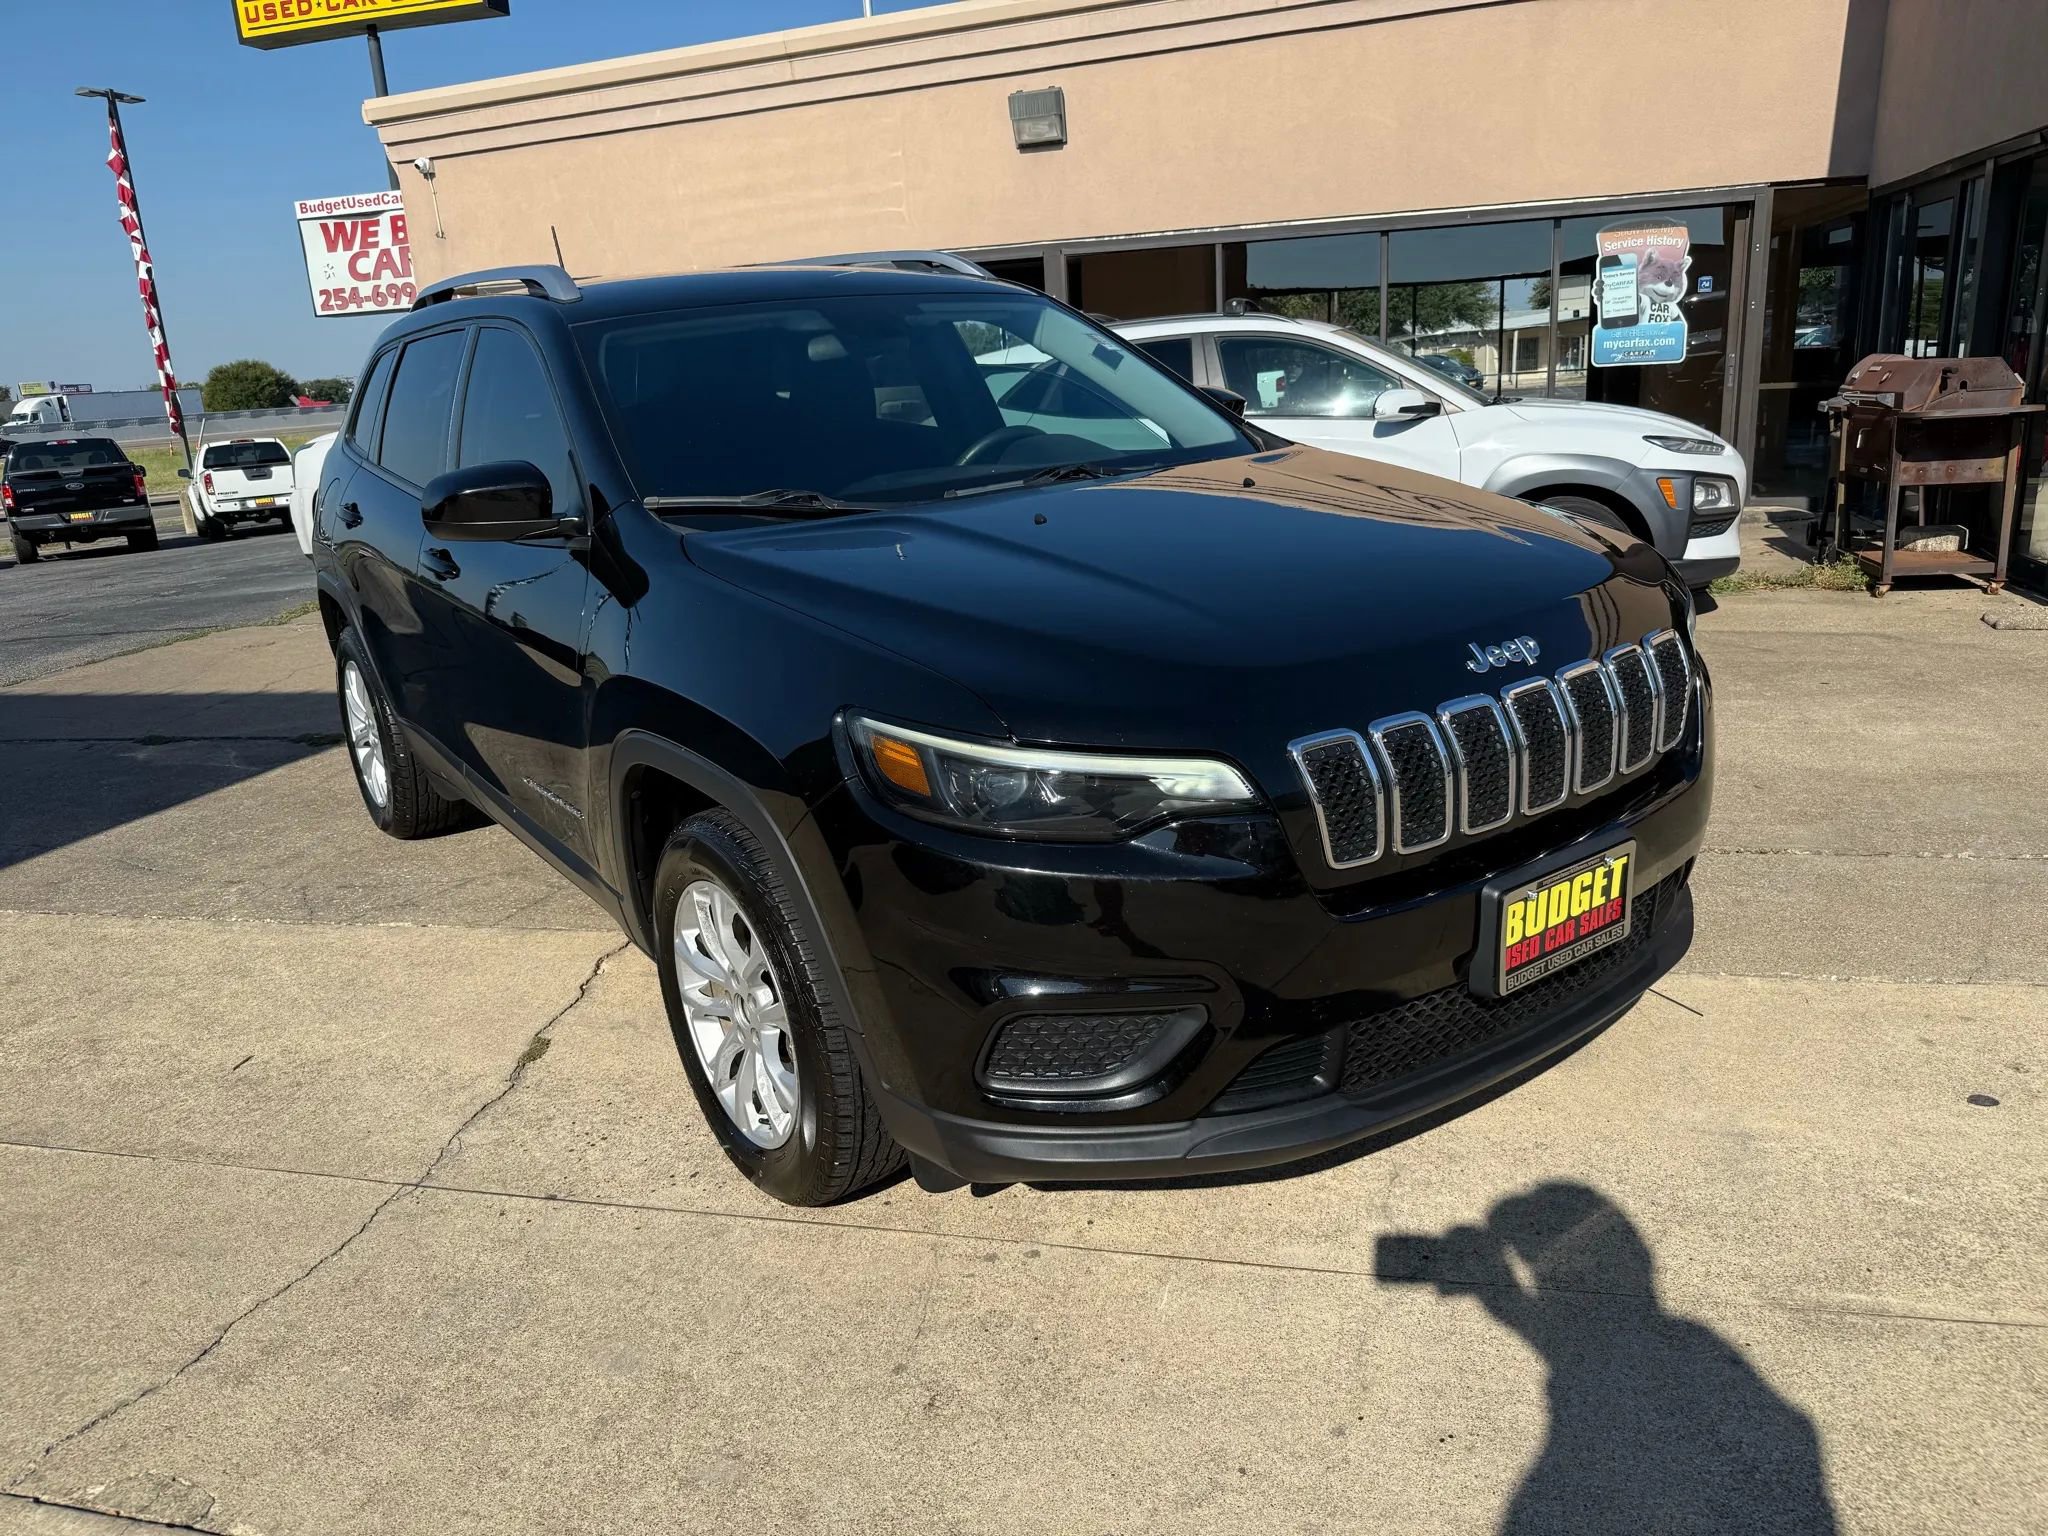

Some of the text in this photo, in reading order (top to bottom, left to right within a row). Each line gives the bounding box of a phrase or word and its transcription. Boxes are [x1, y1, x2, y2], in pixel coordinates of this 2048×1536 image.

[244, 0, 313, 24] USED
[319, 218, 380, 253] WE
[1604, 235, 1685, 252] Service History
[319, 281, 417, 312] 254-699
[1650, 302, 1670, 314] CAR
[1648, 314, 1670, 323] FOX
[1603, 337, 1676, 350] mycarfax.com
[1465, 635, 1541, 674] Jeep
[1506, 855, 1628, 947] BUDGET
[1544, 918, 1576, 952] CAR
[1579, 897, 1623, 936] SALES
[1507, 926, 1624, 990] BUDGET USED CAR SALES
